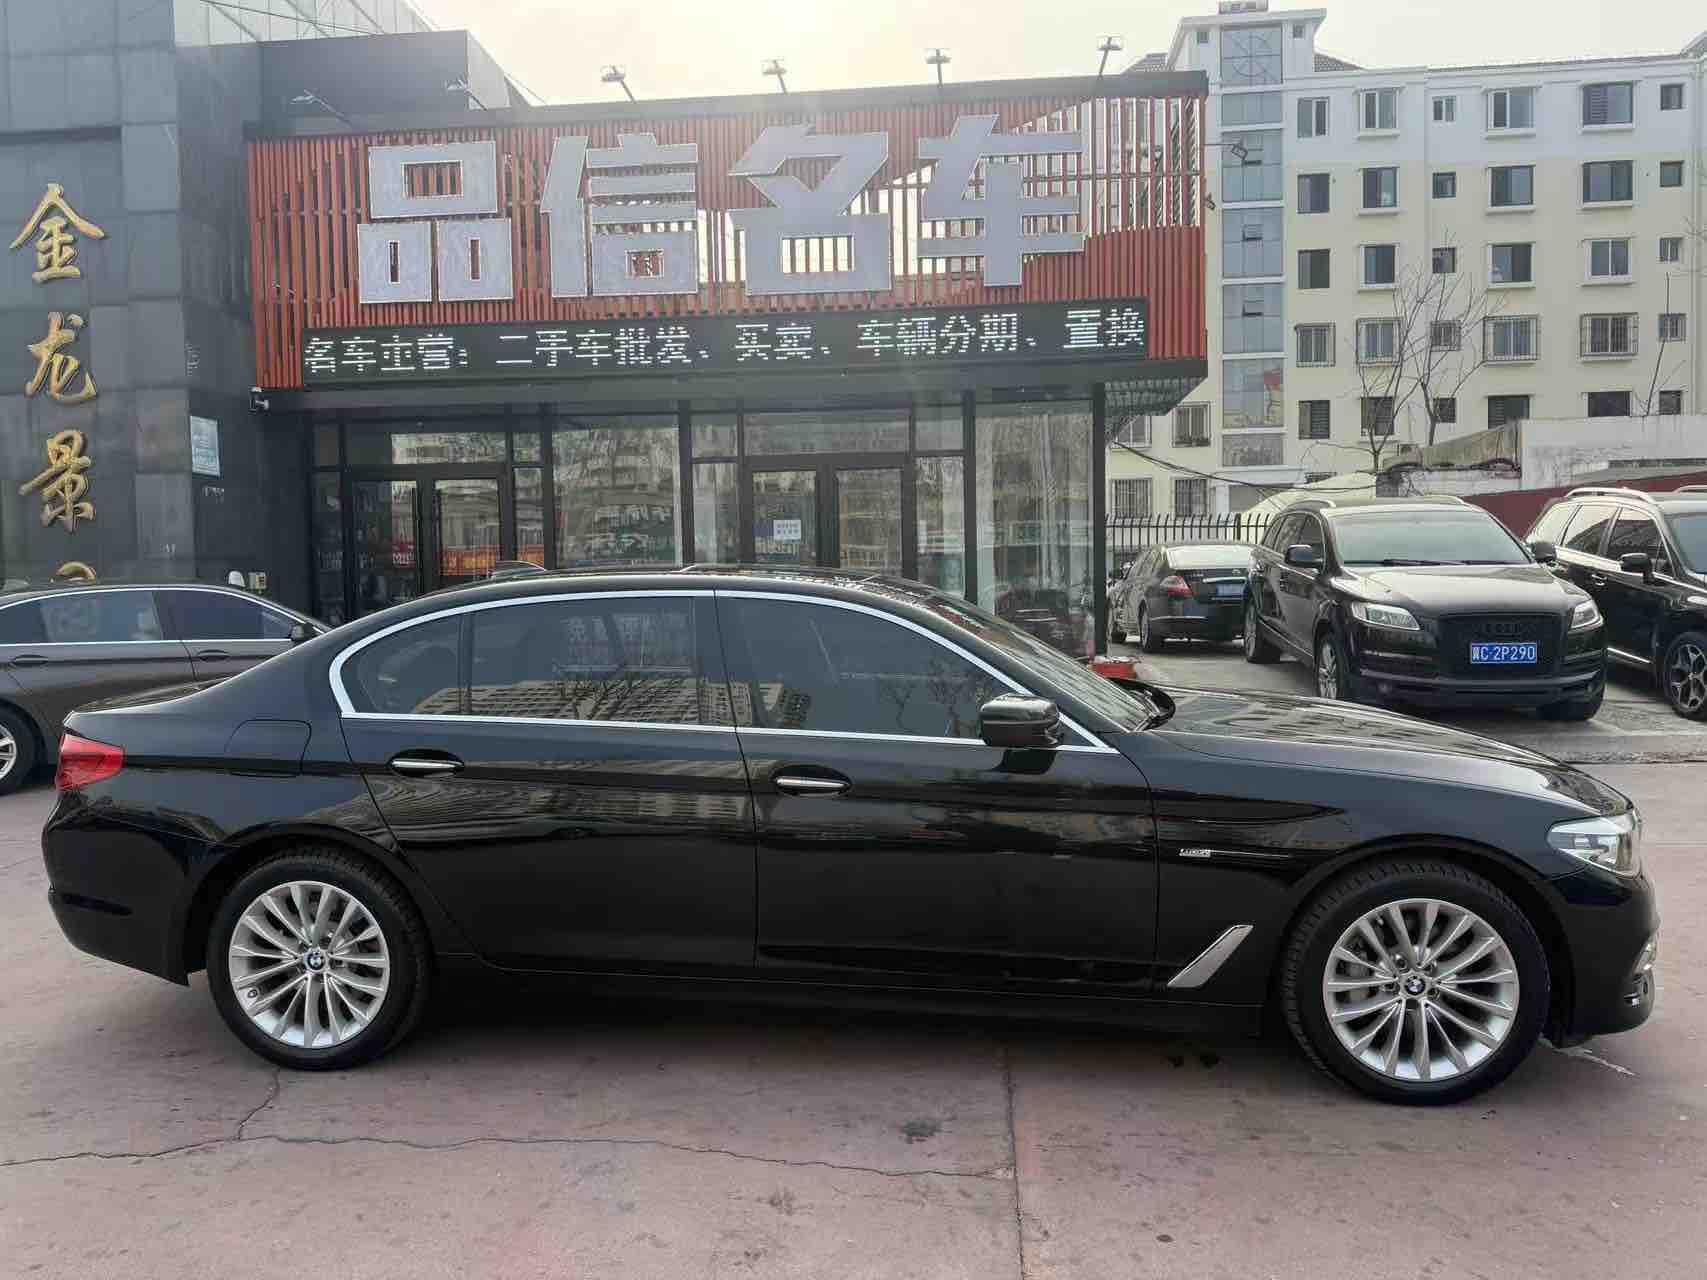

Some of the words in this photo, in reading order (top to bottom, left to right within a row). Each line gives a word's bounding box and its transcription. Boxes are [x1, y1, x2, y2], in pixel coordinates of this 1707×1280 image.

[357, 113, 1086, 304] 品信名车
[9, 183, 106, 584] 金龙景
